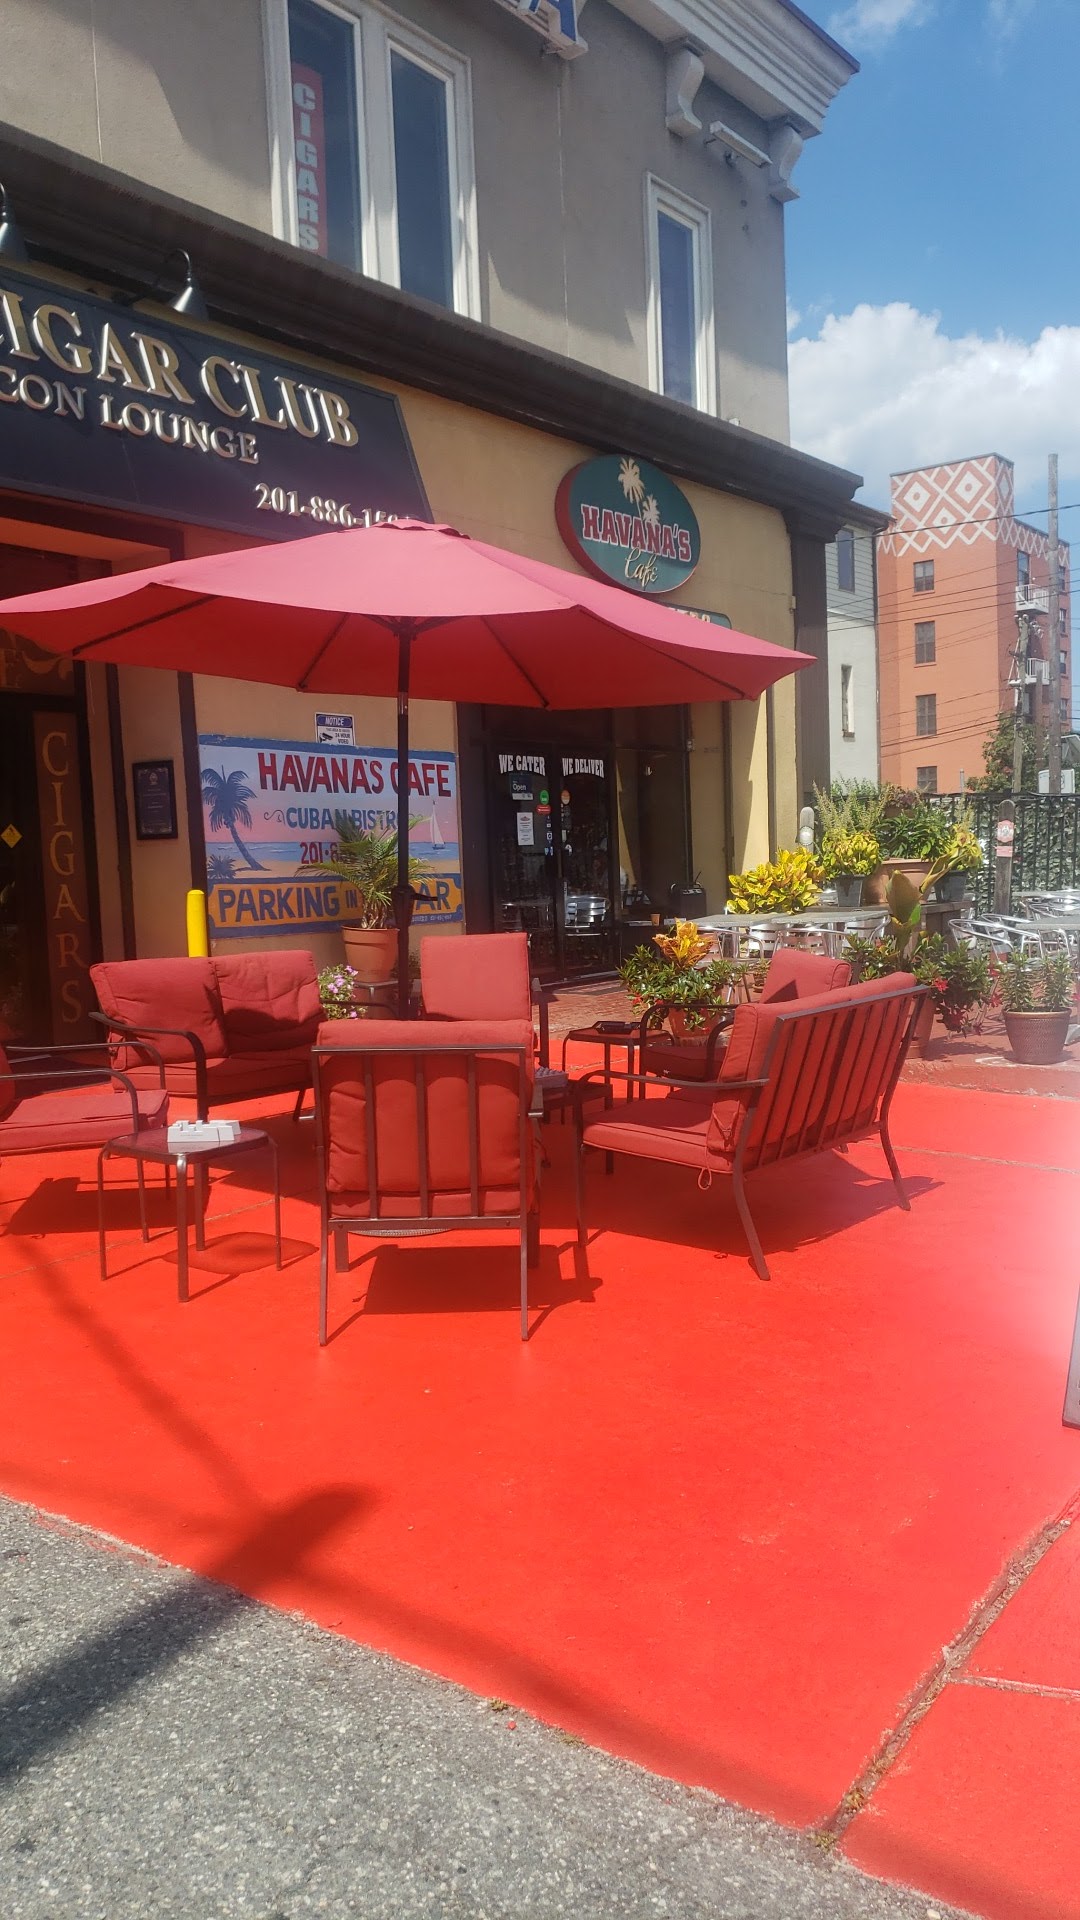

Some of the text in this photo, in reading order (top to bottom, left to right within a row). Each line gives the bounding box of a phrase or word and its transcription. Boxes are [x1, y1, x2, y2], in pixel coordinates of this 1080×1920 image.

[293, 82, 321, 252] CIGARS
[0, 287, 359, 447] IGAR CLUB
[99, 393, 259, 465] LOUNGE
[580, 503, 692, 562] HAVANA'S
[325, 716, 345, 726] NOTICE
[258, 753, 384, 794] HAVANA'S
[499, 754, 546, 777] WE CATER
[562, 757, 604, 778] WE DELIVER
[512, 783, 527, 791] Open
[351, 809, 401, 831] BISTR
[41, 731, 89, 1024] CIGARS
[218, 887, 340, 923] PARKING
[345, 889, 358, 908] IN
